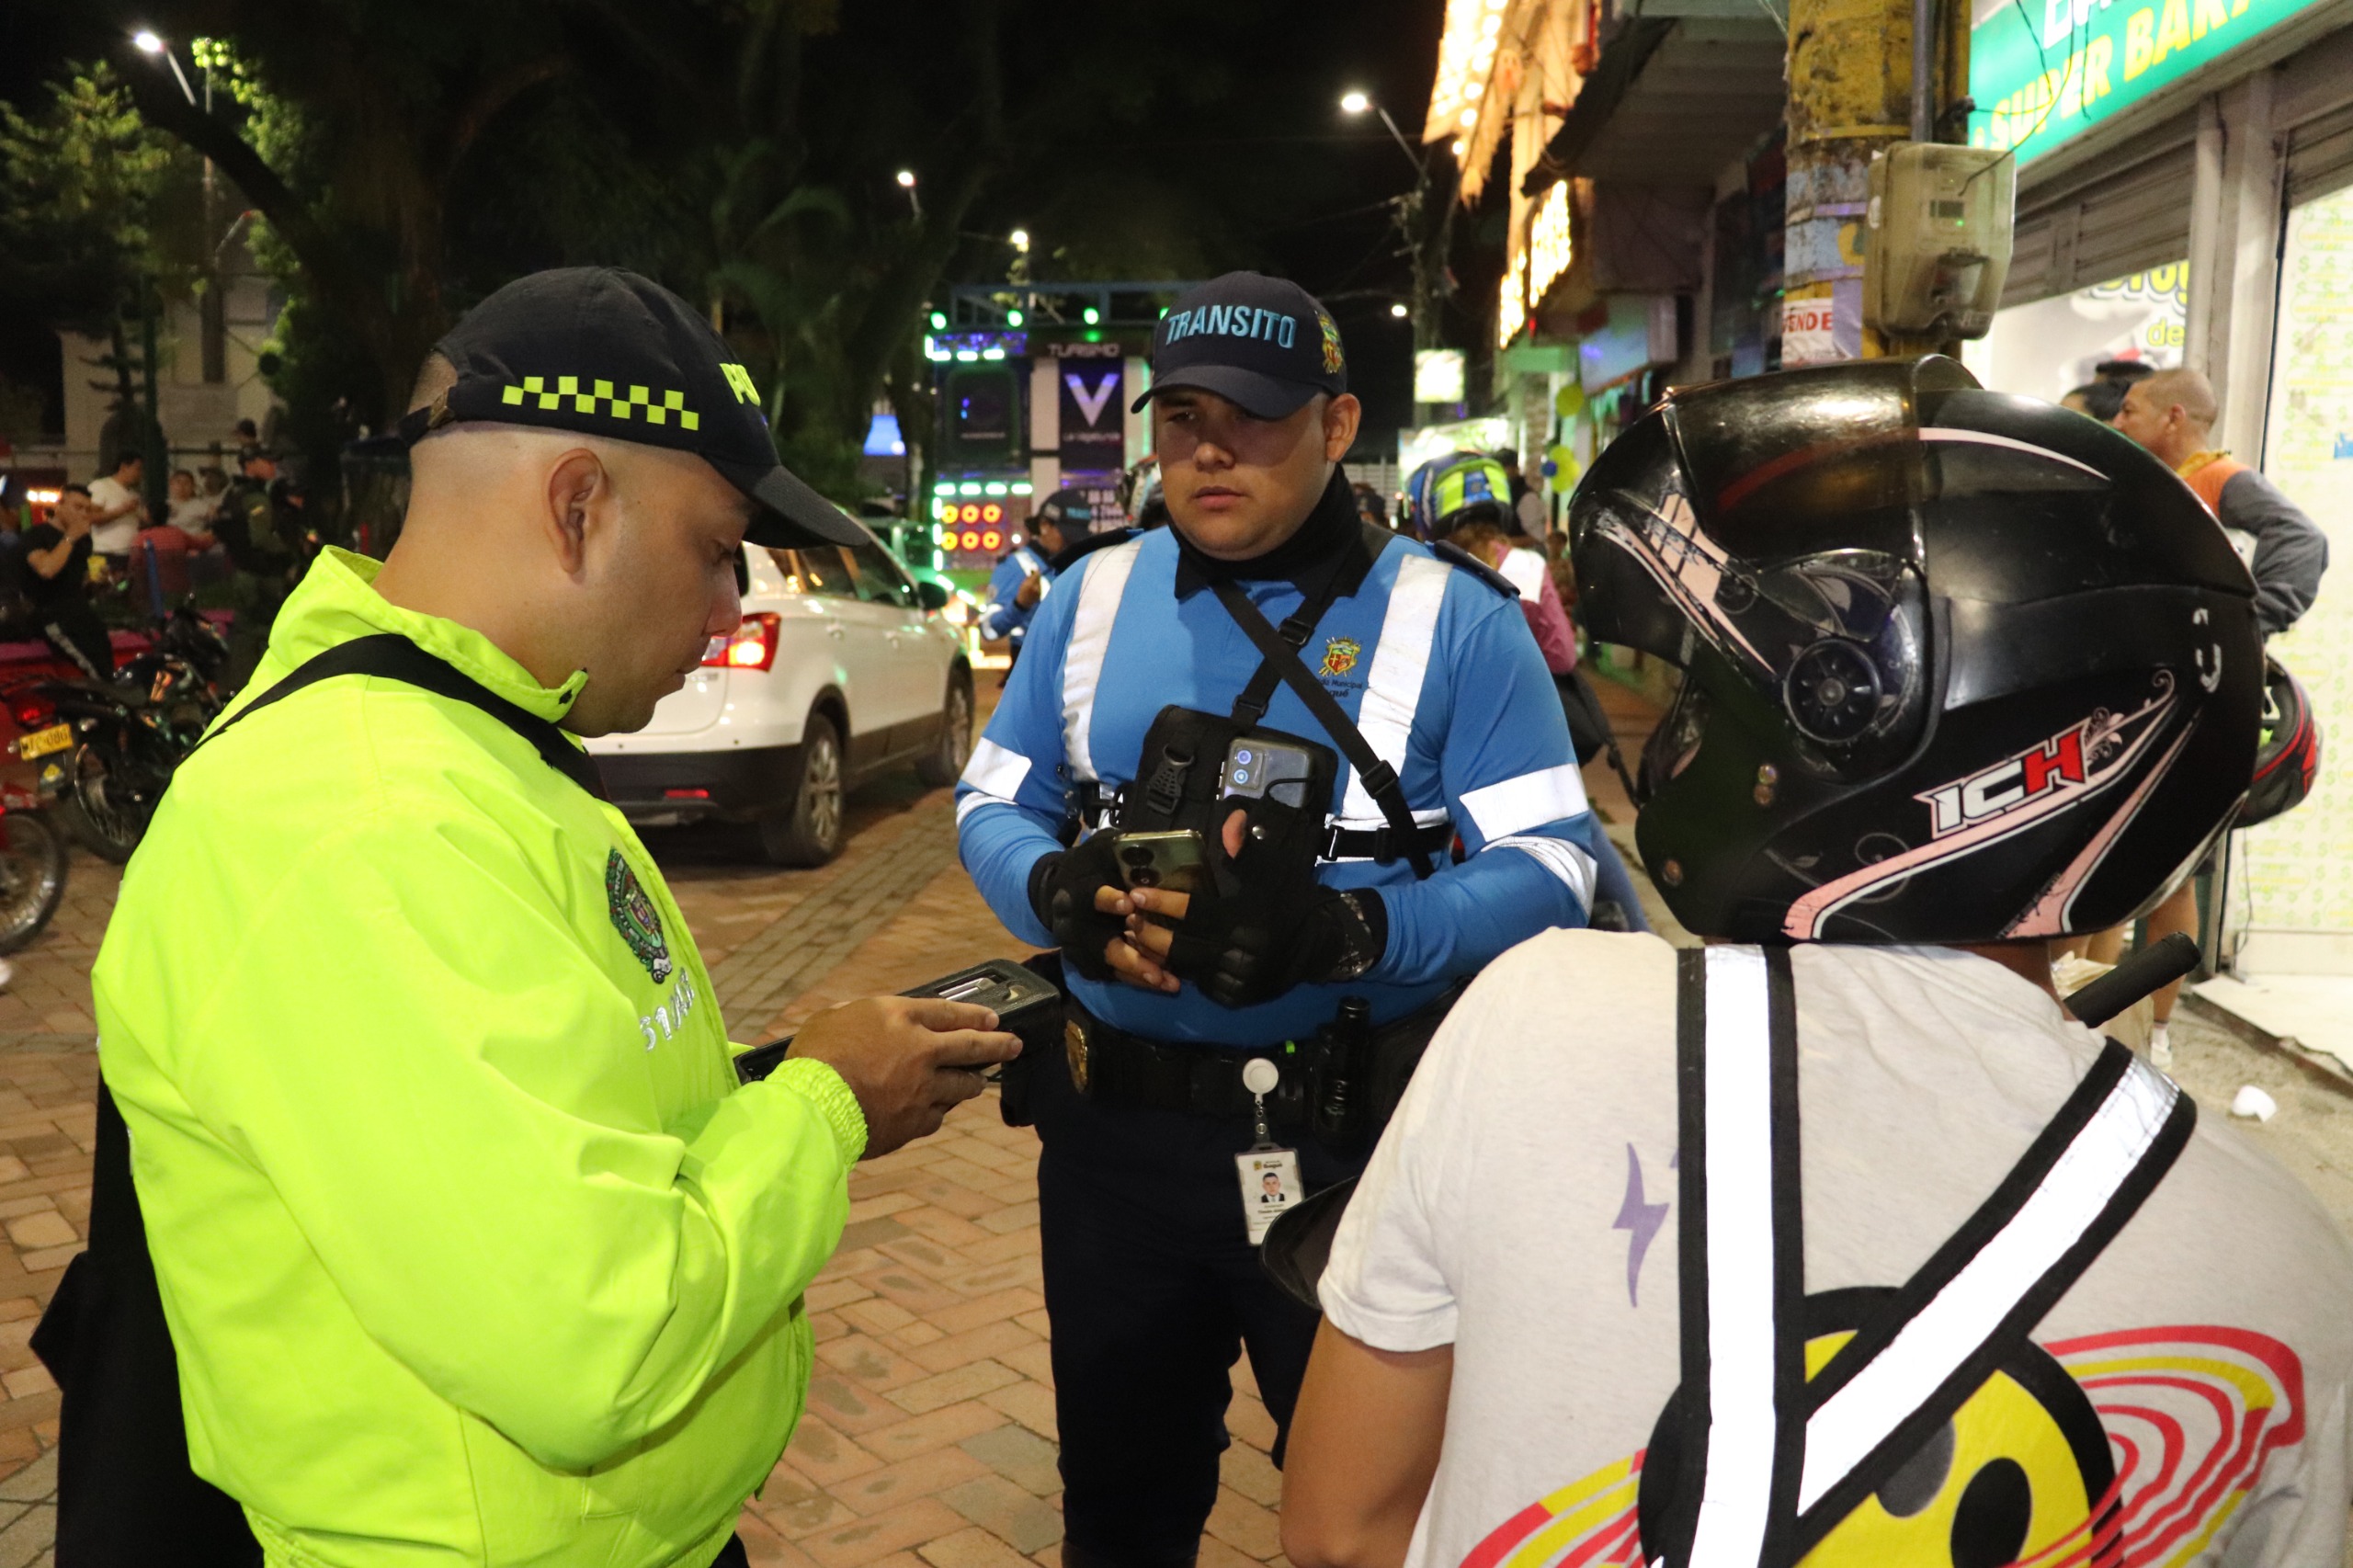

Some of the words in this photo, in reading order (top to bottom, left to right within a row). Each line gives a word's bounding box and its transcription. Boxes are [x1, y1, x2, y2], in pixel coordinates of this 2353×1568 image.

[1990, 34, 2113, 151] SUPER
[1165, 304, 1297, 349] TRANSITO
[1927, 726, 2087, 834] ICH
